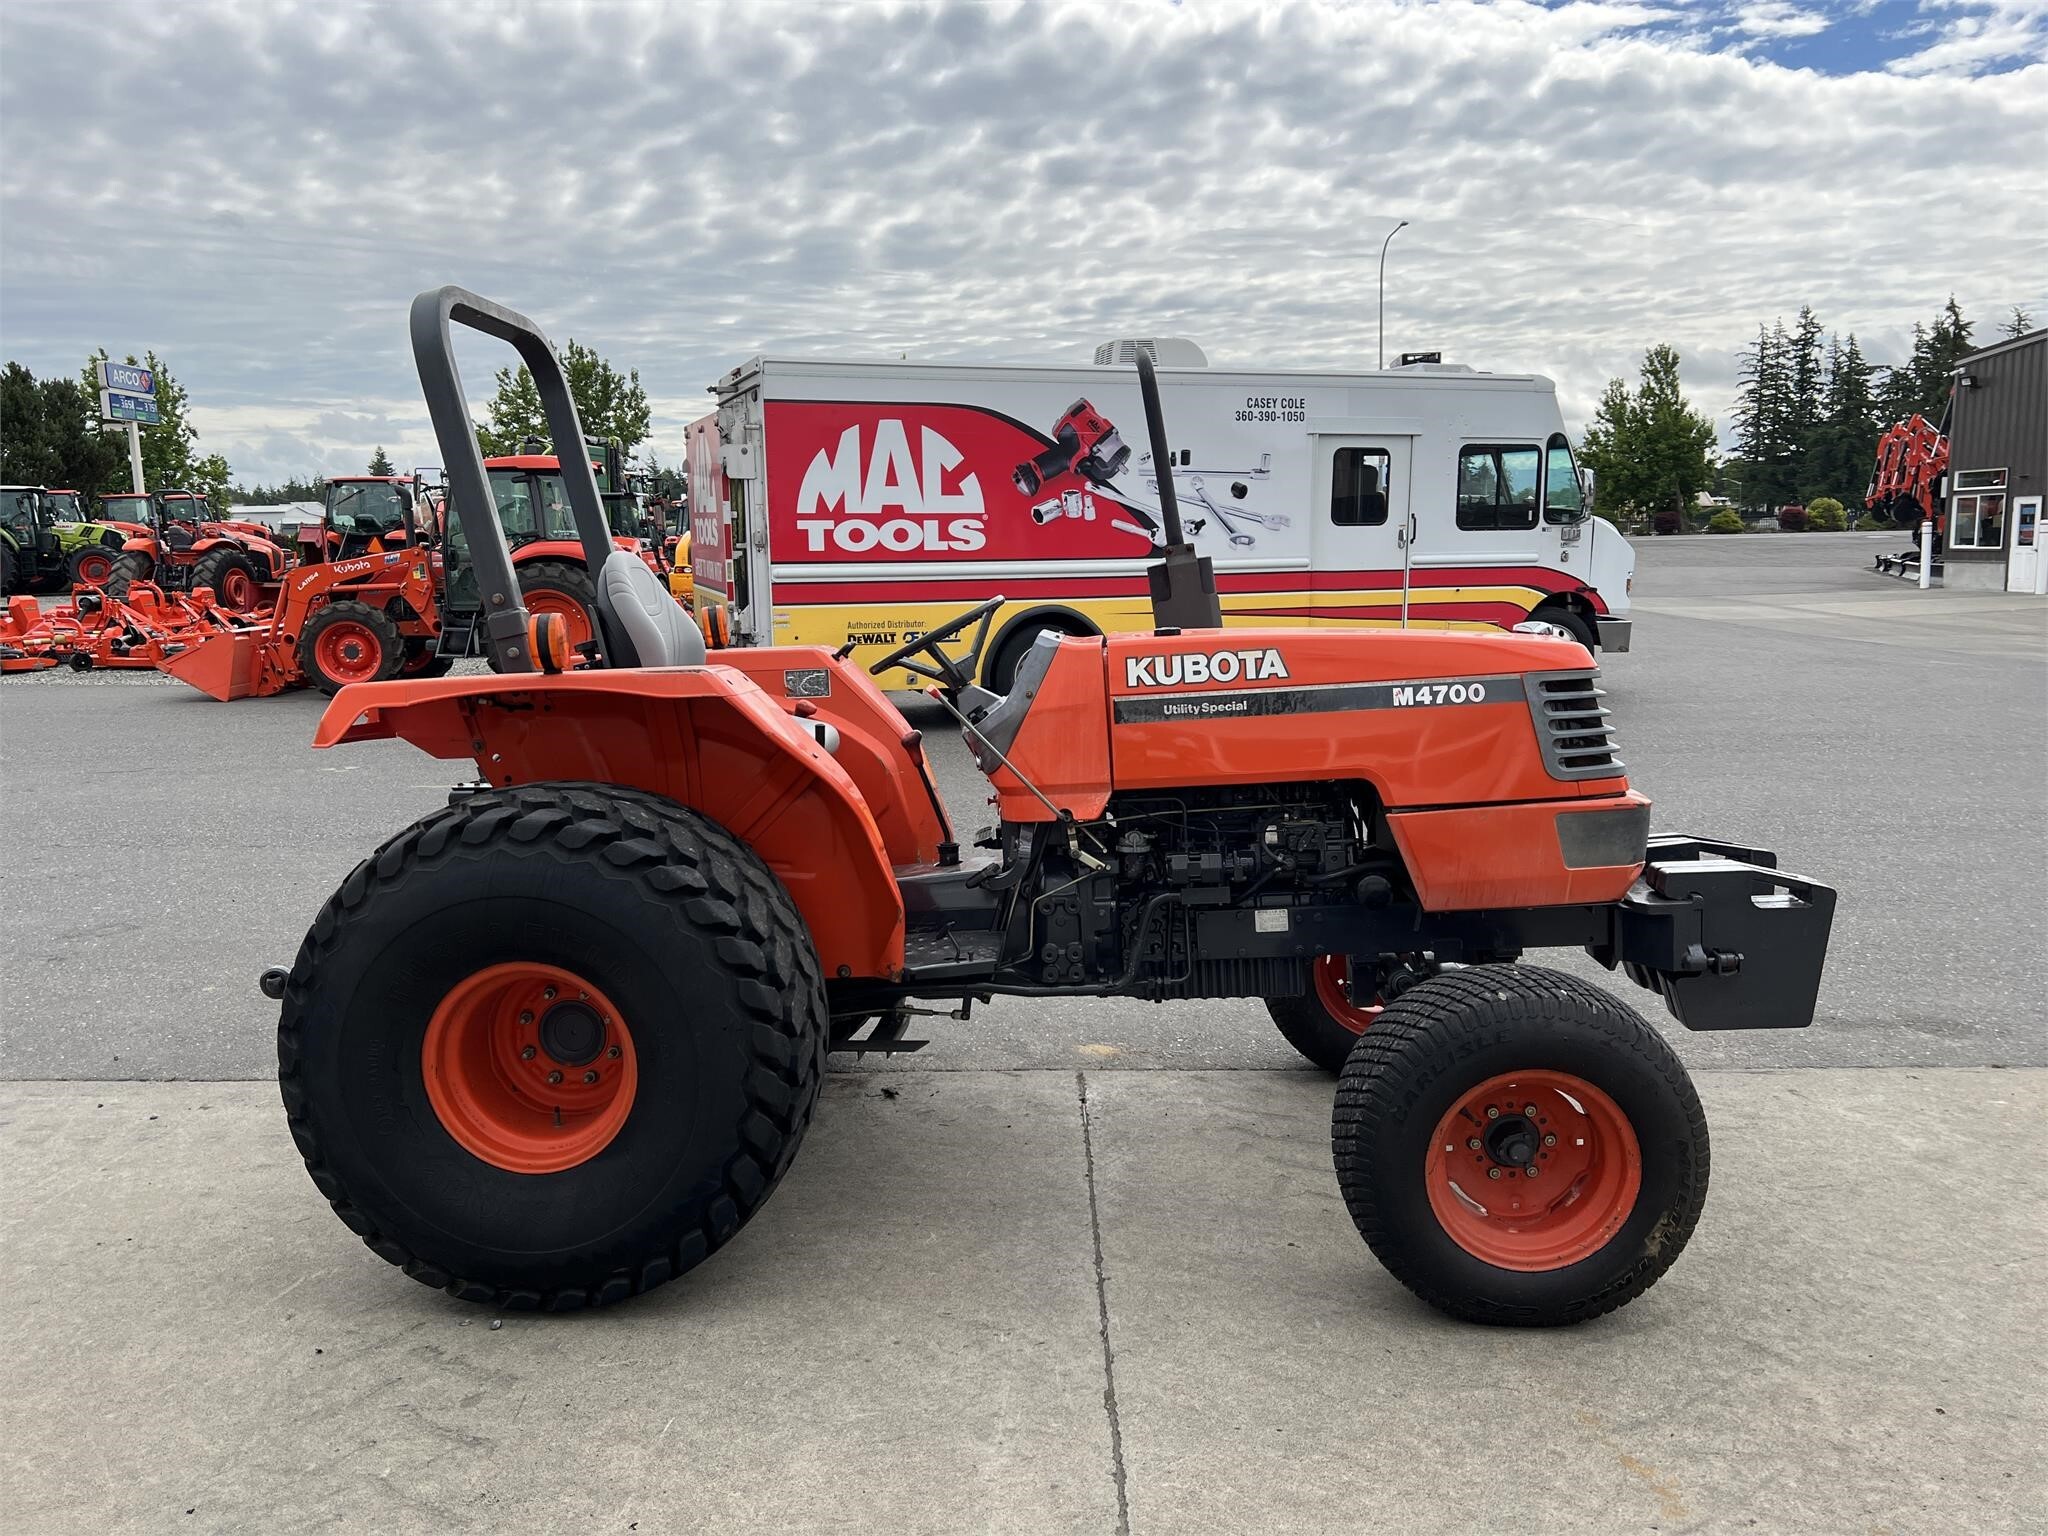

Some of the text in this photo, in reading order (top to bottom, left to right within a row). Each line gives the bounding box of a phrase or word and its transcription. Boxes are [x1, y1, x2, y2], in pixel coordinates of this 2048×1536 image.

[113, 369, 139, 386] ARCO
[1247, 397, 1305, 409] CASEY COLE
[1235, 411, 1305, 422] 360-390-1050
[796, 419, 986, 514] MAC
[695, 517, 718, 548] TOOLS
[796, 519, 987, 552] TOOLS
[334, 561, 371, 574] Kubota
[847, 621, 886, 630] Authorized
[1126, 648, 1290, 688] KUBOTA
[1392, 683, 1486, 706] M4700
[1163, 700, 1248, 715] Utility Special
